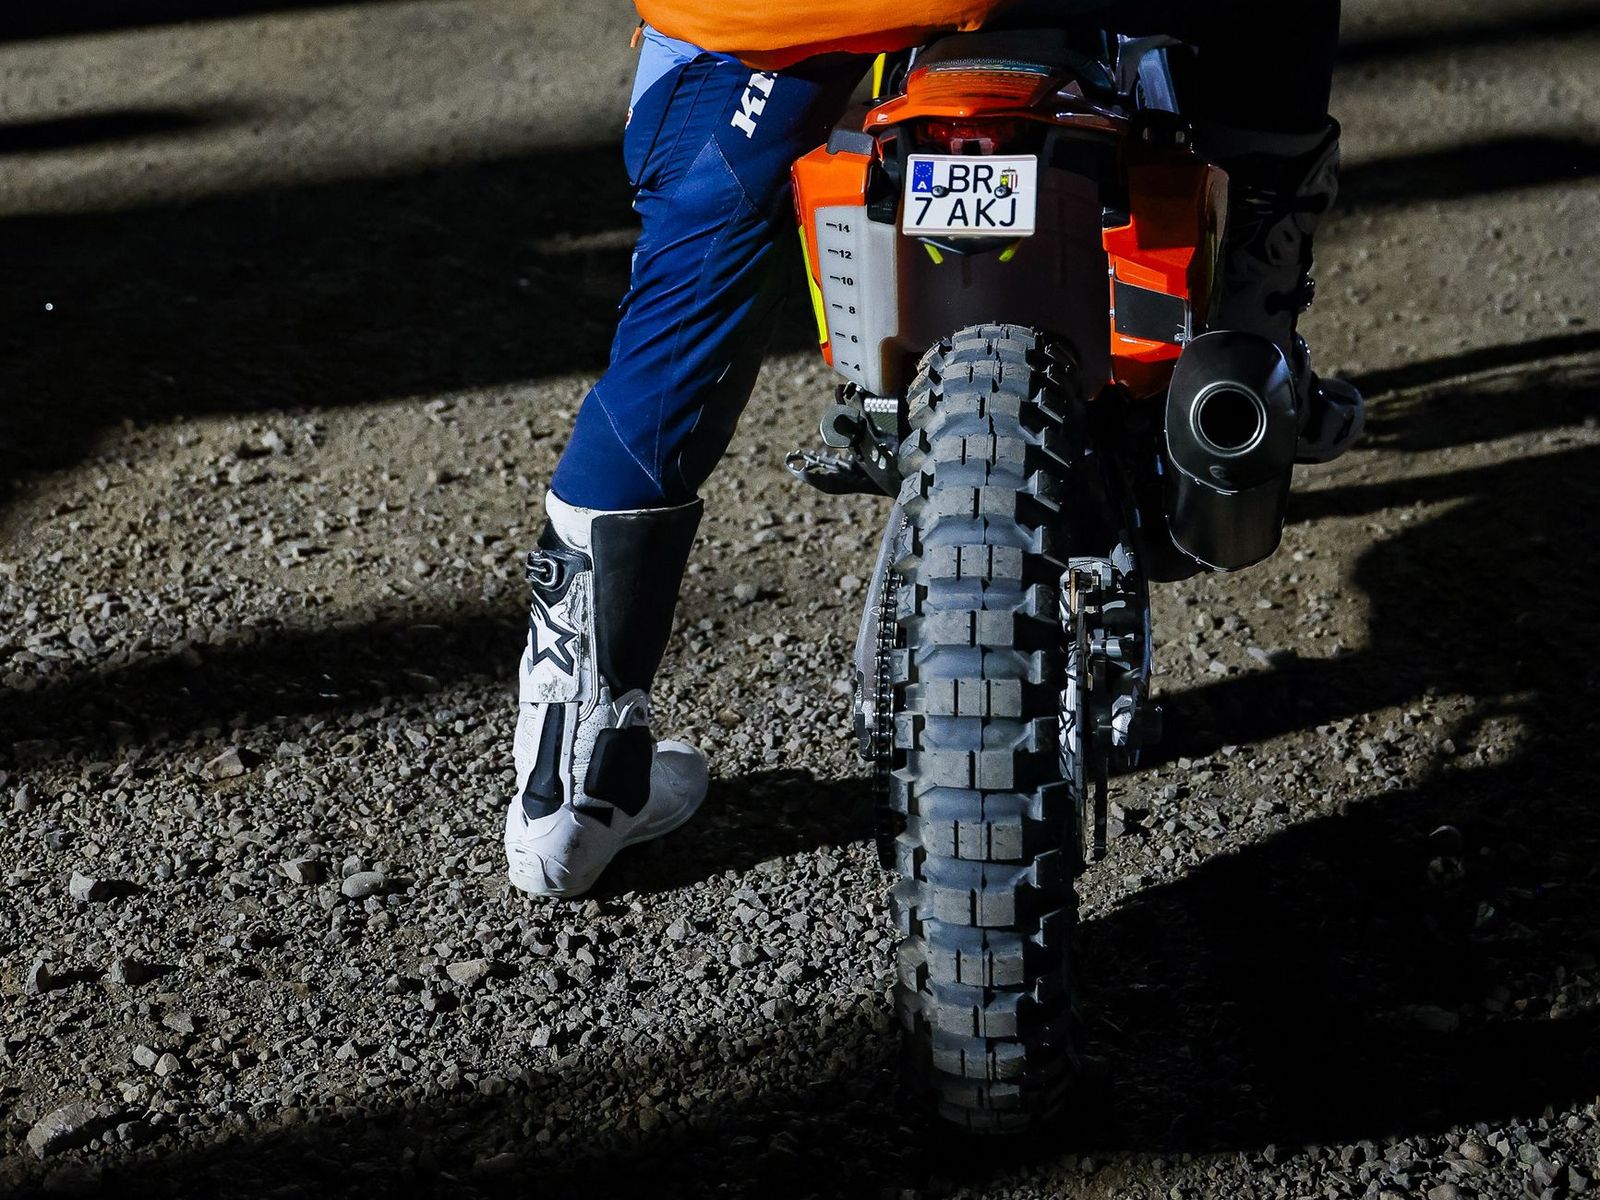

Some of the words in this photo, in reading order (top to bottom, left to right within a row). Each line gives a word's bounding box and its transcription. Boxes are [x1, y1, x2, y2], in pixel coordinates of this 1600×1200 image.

[948, 164, 994, 194] BR
[917, 181, 928, 190] A
[915, 197, 933, 226] 7
[947, 198, 1016, 227] AKJ
[838, 223, 850, 233] 14
[839, 249, 852, 260] 12
[841, 276, 854, 286] 10
[848, 306, 856, 314] 8
[851, 335, 859, 344] 6
[854, 363, 861, 372] 4
